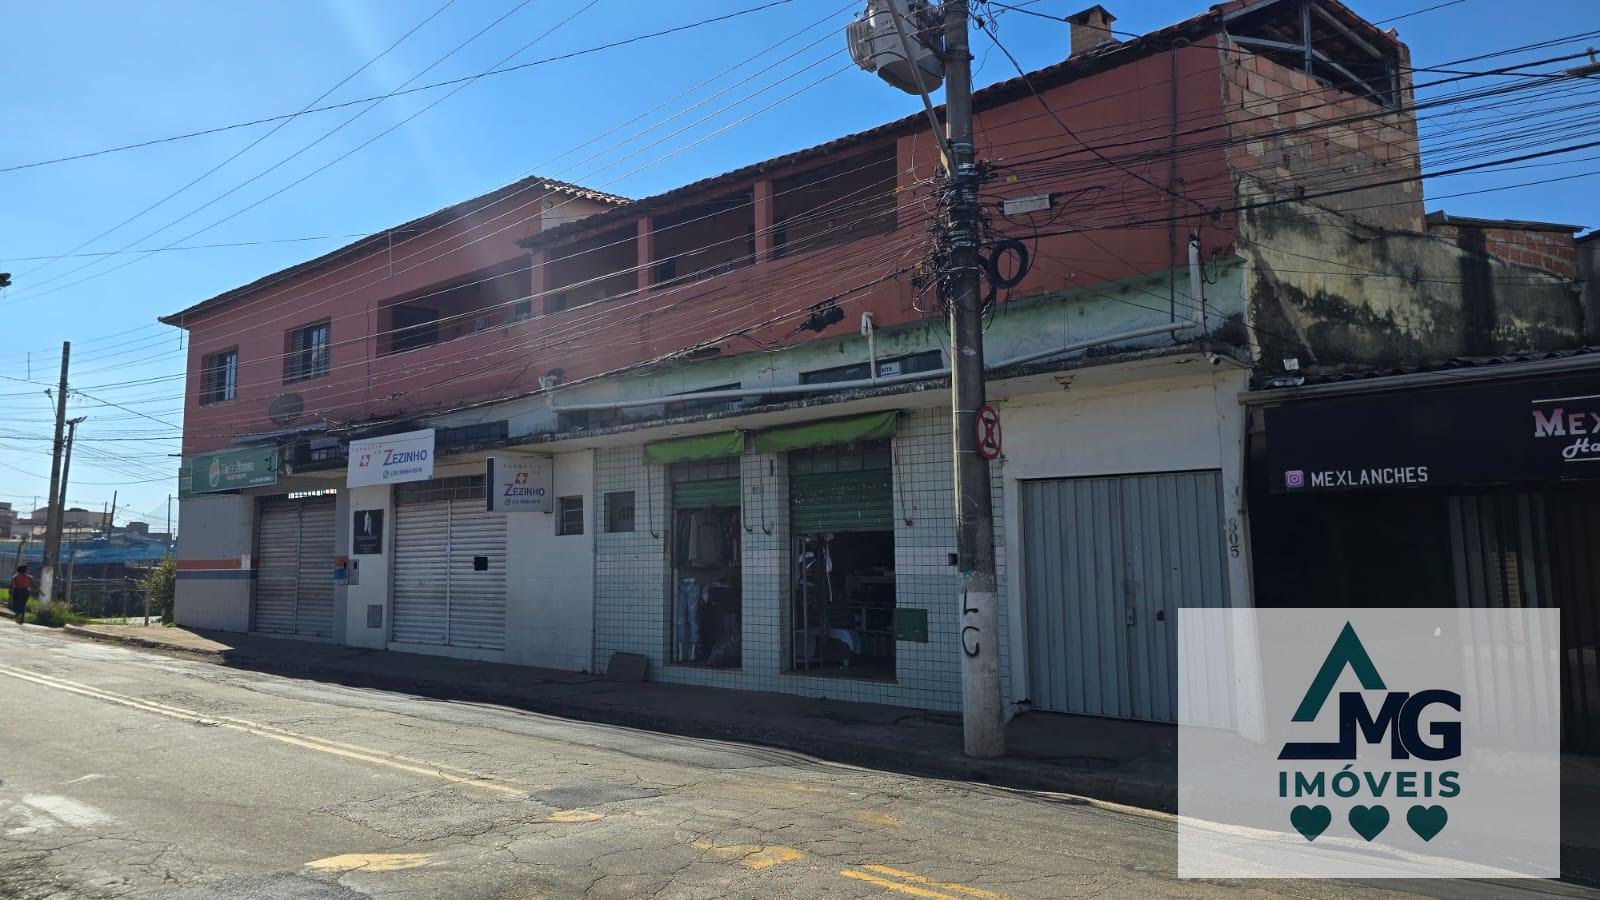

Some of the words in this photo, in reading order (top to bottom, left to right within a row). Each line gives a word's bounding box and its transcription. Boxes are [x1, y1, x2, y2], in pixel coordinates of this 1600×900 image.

[382, 448, 428, 467] ZEZINHO
[1311, 466, 1428, 487] MEXLANCHES
[503, 483, 546, 497] ZEZINHO
[1229, 518, 1240, 558] 805
